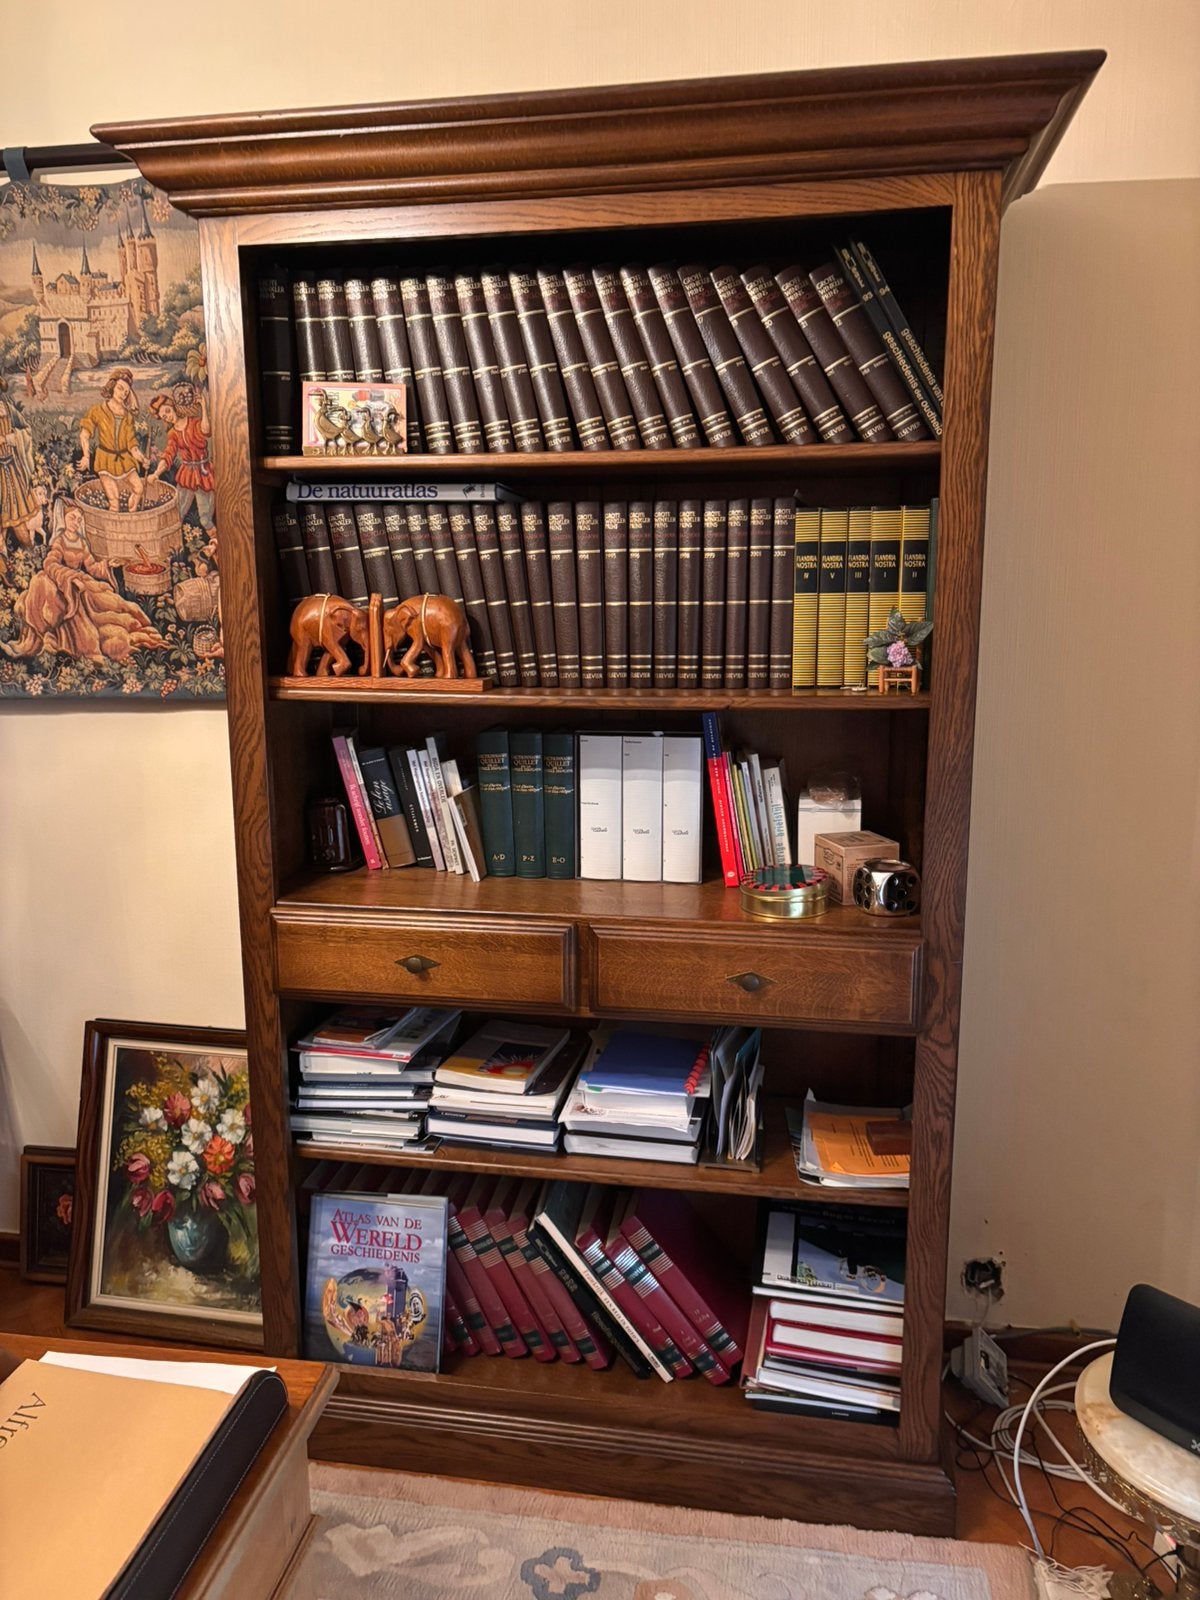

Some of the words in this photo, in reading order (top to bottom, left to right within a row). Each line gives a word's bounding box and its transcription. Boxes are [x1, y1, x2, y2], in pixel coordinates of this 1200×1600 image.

[683, 273, 701, 285] GROTE
[716, 276, 733, 288] GROTE
[746, 277, 764, 290] GROTE
[782, 277, 800, 291] GROTE
[816, 275, 834, 289] GROTE
[863, 291, 873, 302] 93
[883, 331, 918, 389] geschiedenis
[914, 389, 923, 401] der
[900, 328, 936, 386] geschiedenis
[297, 484, 323, 499] De
[328, 483, 438, 499] natuuratlas
[370, 780, 382, 799] bon
[380, 778, 394, 811] usage
[350, 790, 360, 807] schrijf
[356, 807, 365, 826] zonder
[373, 799, 386, 814] Le
[332, 1208, 371, 1225] ATLAS
[376, 1215, 399, 1228] VAN
[404, 1218, 423, 1231] DE
[331, 1220, 423, 1252] WERELD
[331, 1244, 421, 1264] GESCHIEDENIS
[581, 1268, 605, 1296] Frankrijk
[0, 1392, 46, 1449] Alfre
